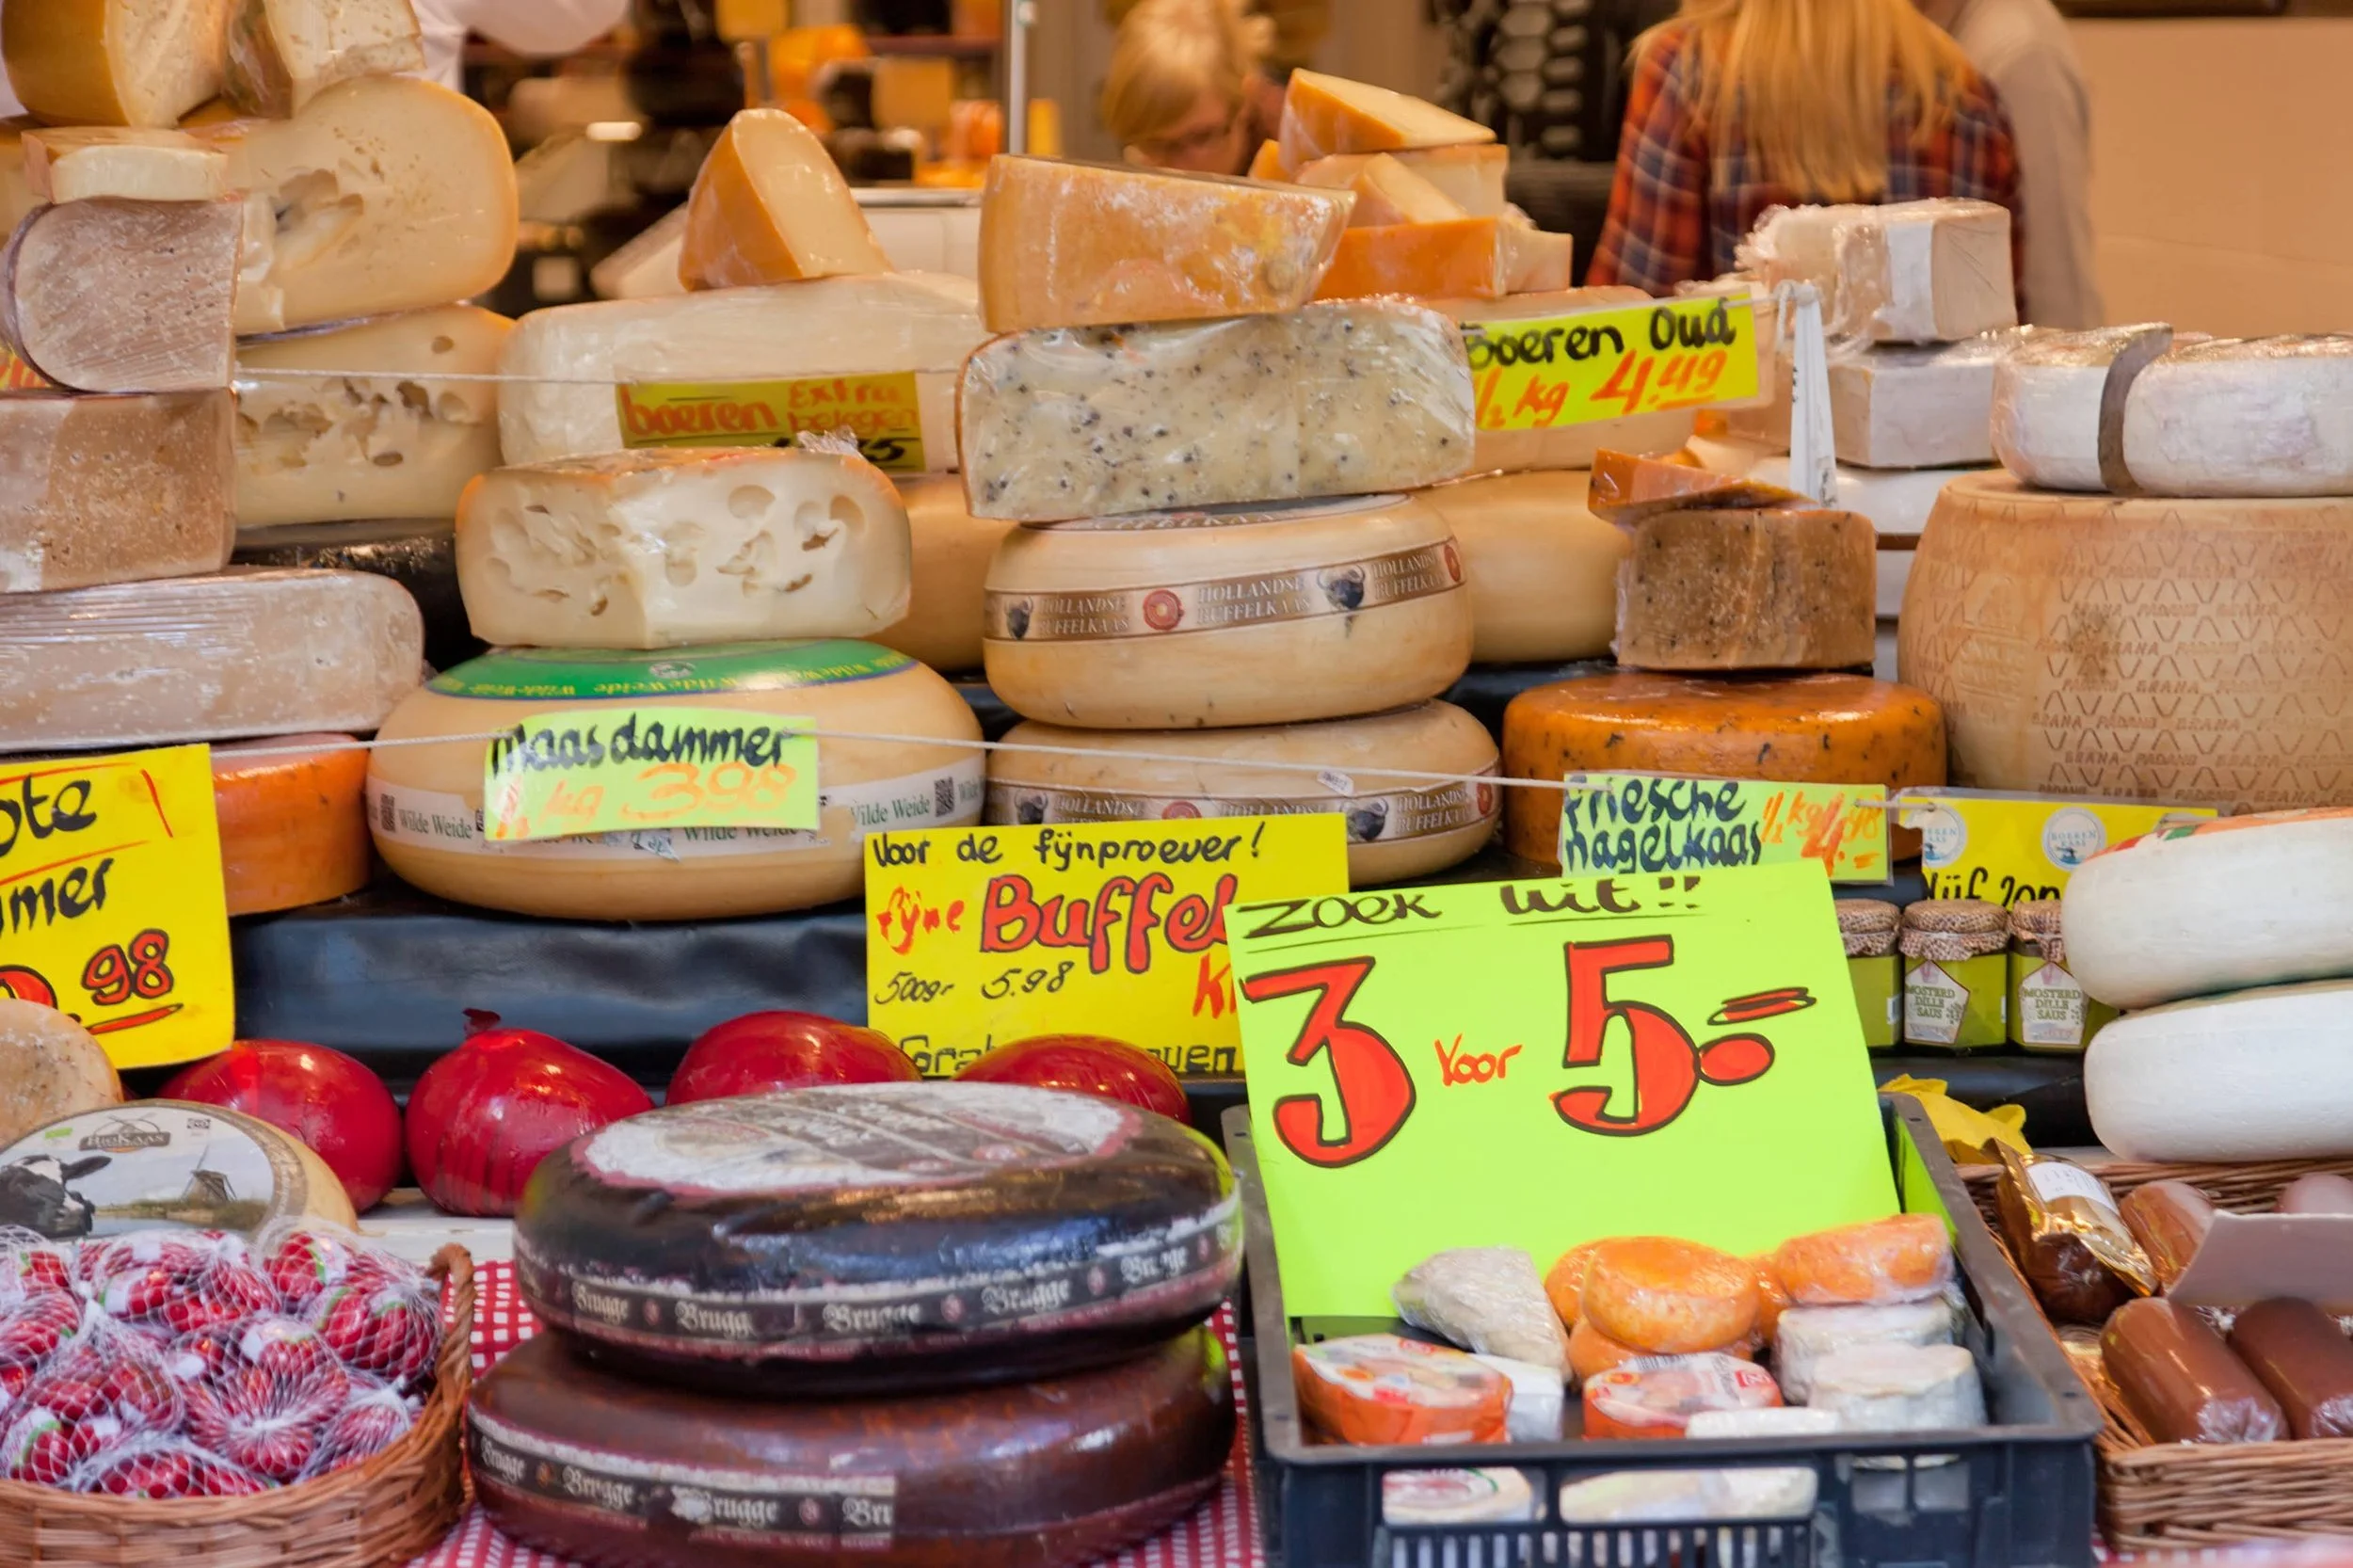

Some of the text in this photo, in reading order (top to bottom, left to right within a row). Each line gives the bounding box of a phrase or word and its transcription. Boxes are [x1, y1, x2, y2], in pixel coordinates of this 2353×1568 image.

[1649, 296, 1737, 350] Oud
[1513, 374, 1570, 428] kg
[1589, 349, 1728, 415] 4.49
[398, 808, 473, 840] Wilde Weide
[892, 796, 932, 822] Weide
[956, 834, 1003, 865] de
[980, 872, 1240, 974] Buffel
[981, 961, 1075, 1000] 5.98
[1192, 952, 1242, 1020] K
[1907, 986, 1956, 999] MOSTERD
[2024, 988, 2080, 1000] MOSTERD
[1914, 997, 1945, 1008] DILLE
[1916, 1007, 1943, 1019] SAUS
[2035, 1000, 2069, 1010] DILLE
[2037, 1010, 2067, 1020] SAUS
[1239, 955, 1417, 1169] 3
[674, 1302, 757, 1340] Brugg
